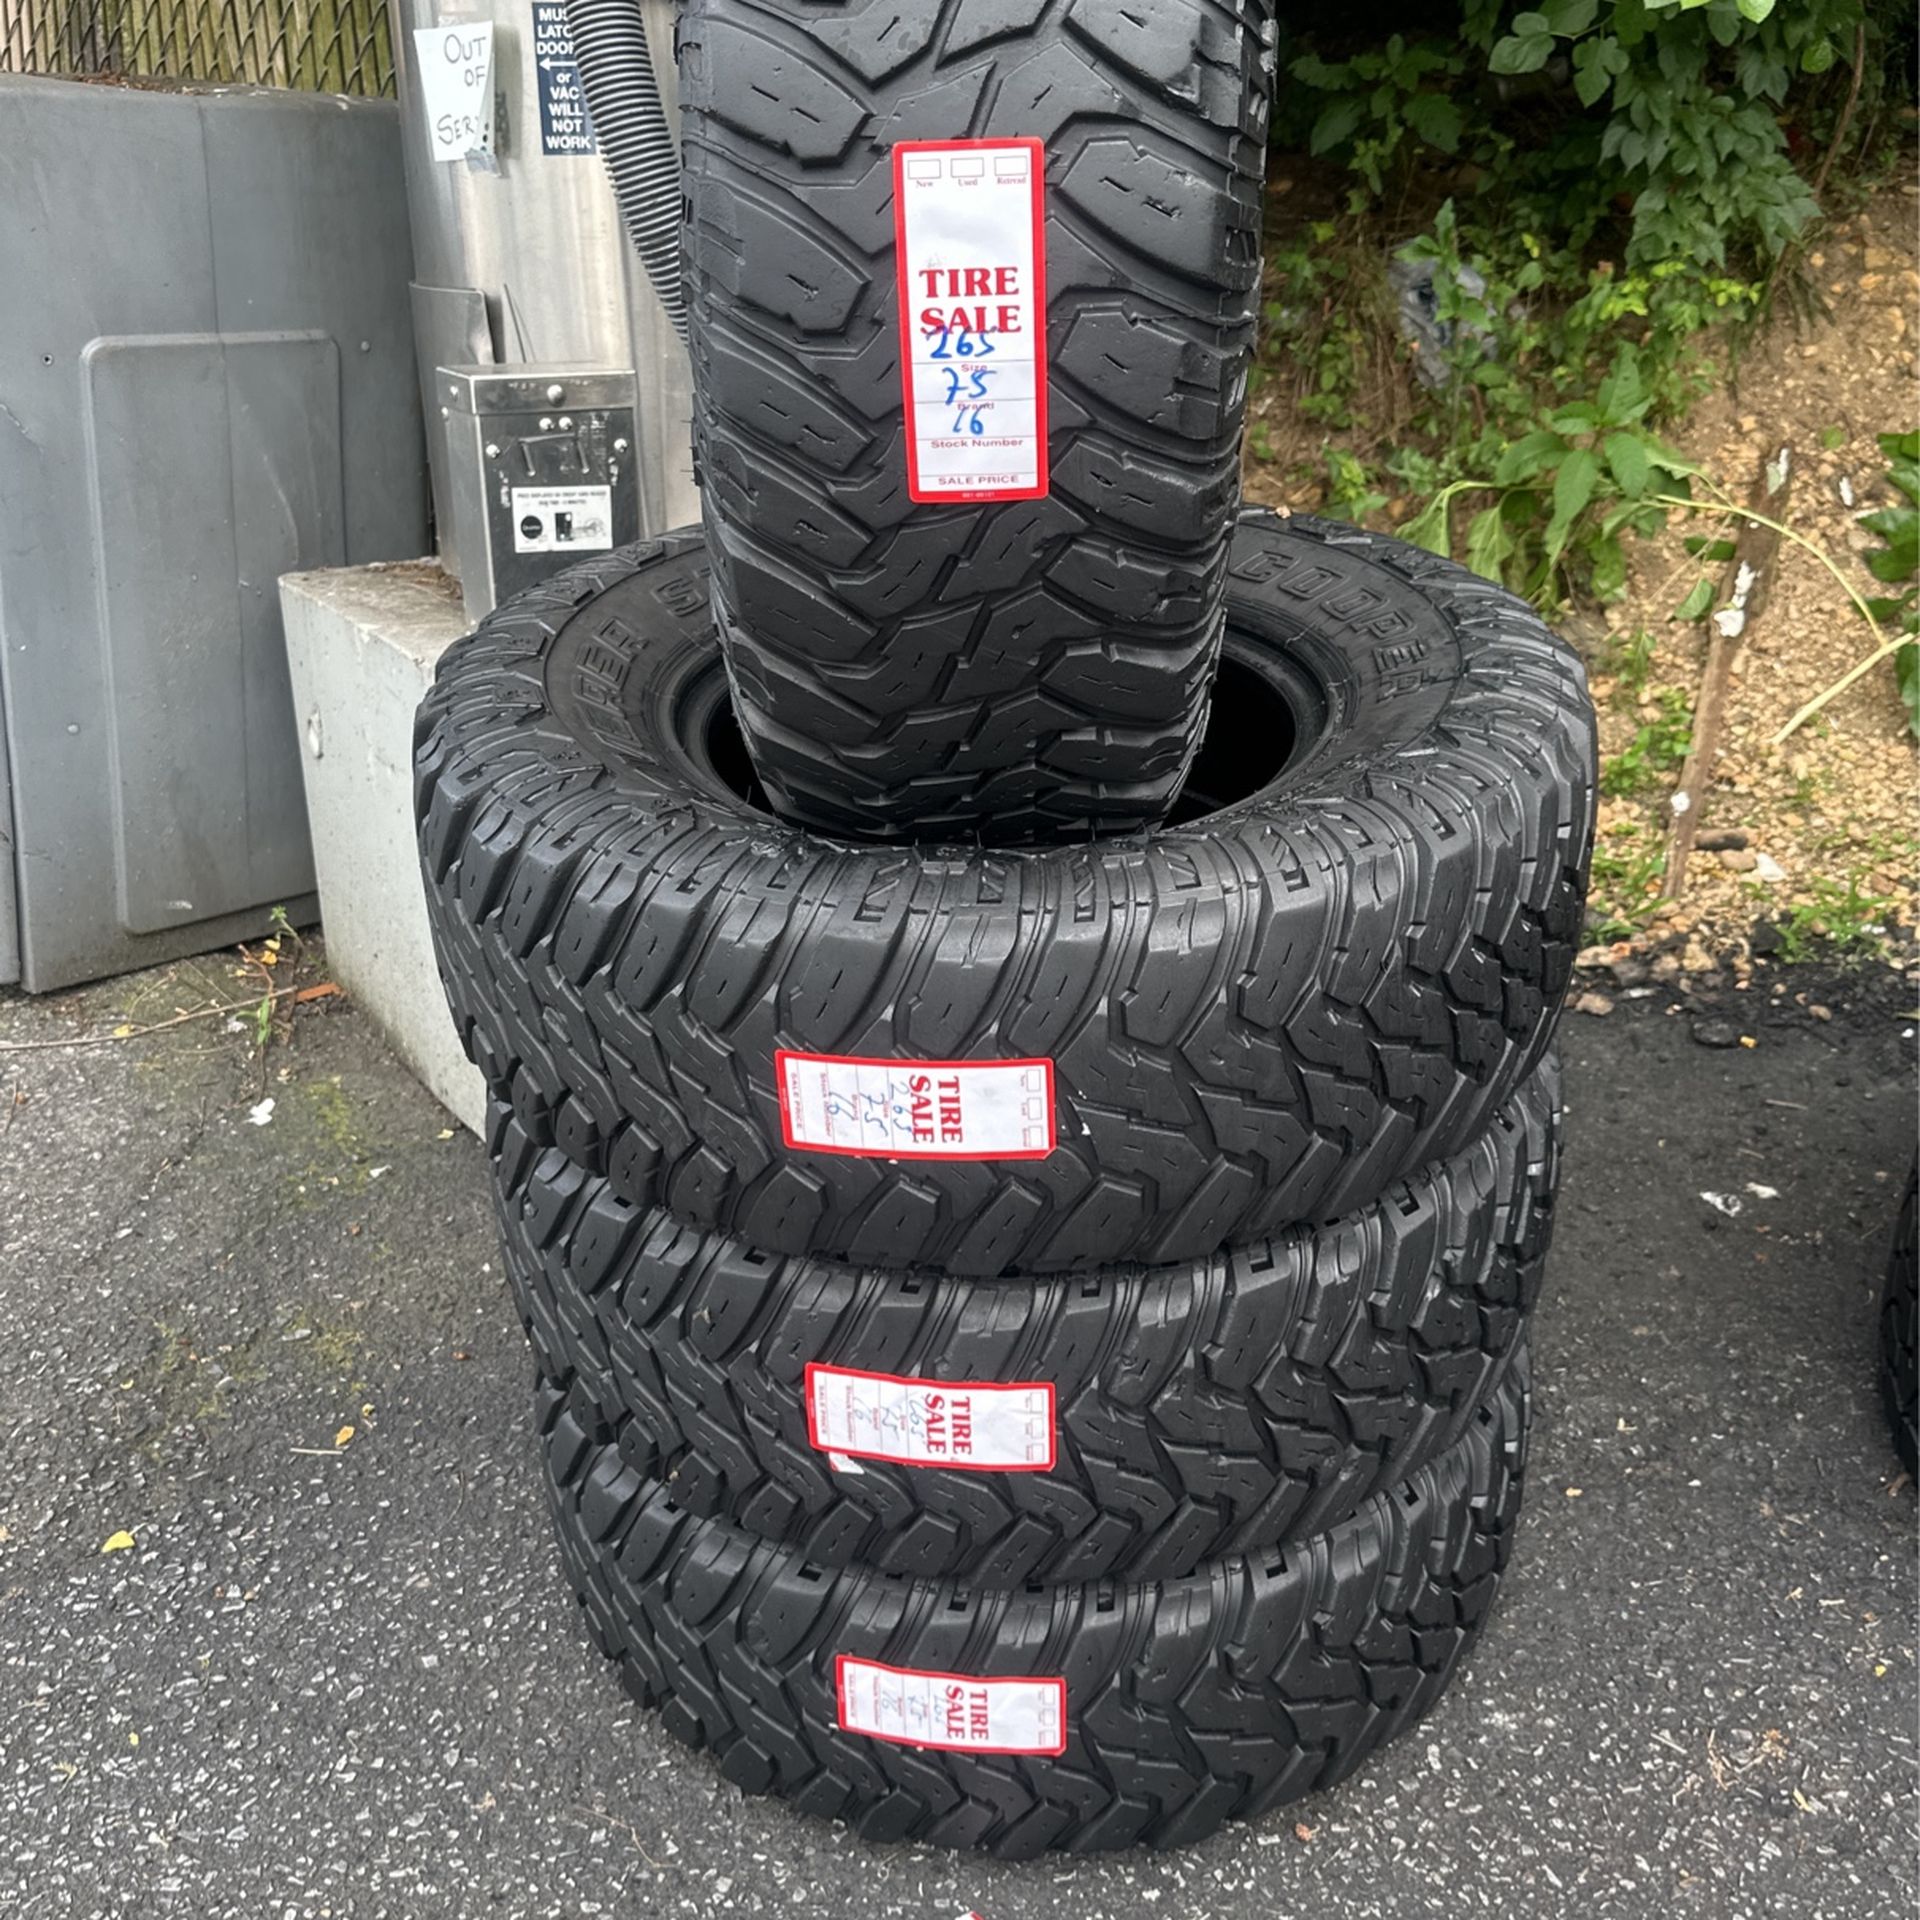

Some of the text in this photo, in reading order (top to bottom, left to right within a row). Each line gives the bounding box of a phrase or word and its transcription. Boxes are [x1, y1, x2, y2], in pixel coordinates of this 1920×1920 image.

[537, 25, 573, 38] LATC
[444, 34, 487, 64] OUT
[464, 66, 487, 87] OF
[556, 72, 571, 84] or
[550, 87, 580, 100] VAC
[549, 103, 584, 117] WILL
[551, 119, 583, 132] NOT
[437, 113, 480, 146] SER
[546, 136, 592, 149] WORK
[919, 267, 1019, 298] TIRE
[920, 304, 1021, 334] SALE
[926, 326, 1000, 359] 265
[961, 363, 988, 373] Size
[942, 366, 997, 406] 75
[952, 404, 984, 436] 16
[931, 437, 1023, 449] Stock Number
[938, 474, 1019, 486] SALE PRICE
[1228, 550, 1429, 703] COOPER
[859, 1092, 889, 1137] 75
[889, 1081, 912, 1134] 265
[909, 1074, 935, 1144] SALE
[938, 1075, 963, 1143] TIRE
[925, 1393, 946, 1454] SALE
[951, 1396, 972, 1455] TIRE
[945, 1685, 965, 1740] SALE
[970, 1689, 989, 1741] TIRE
